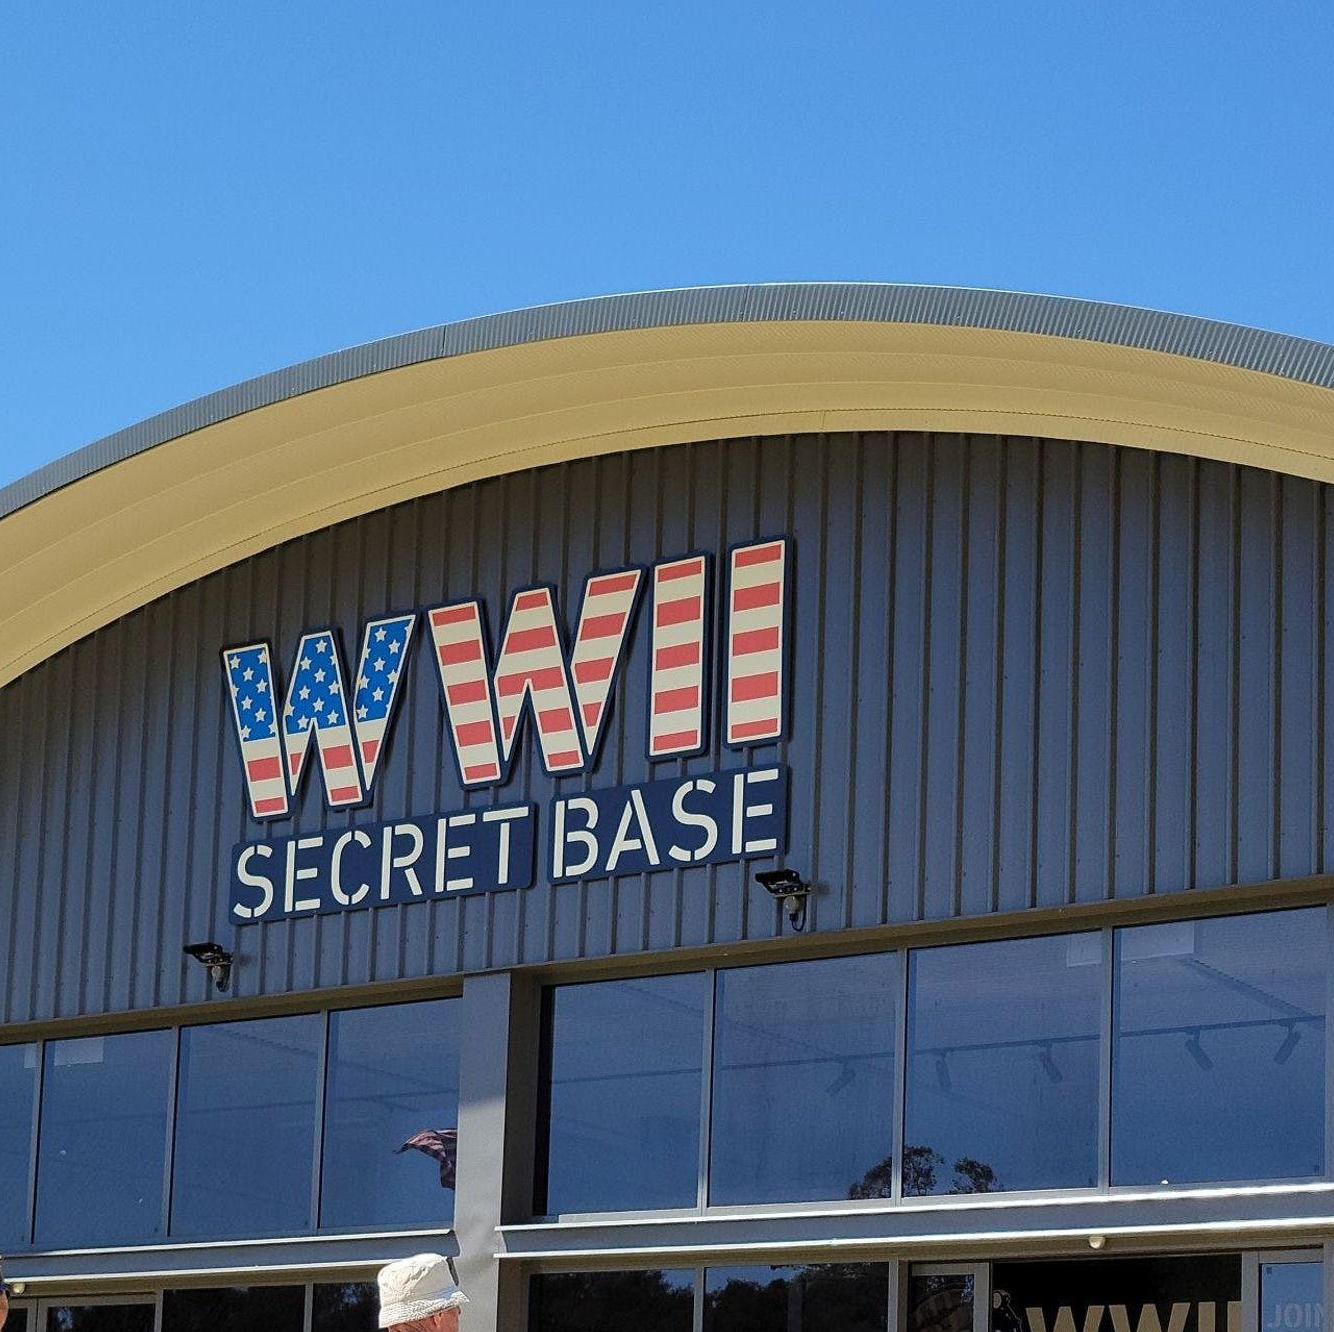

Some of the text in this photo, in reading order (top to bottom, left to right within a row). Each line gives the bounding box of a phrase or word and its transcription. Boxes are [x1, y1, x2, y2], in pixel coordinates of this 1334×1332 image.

[222, 538, 787, 818] WWII
[232, 767, 779, 919] SECRET BASE
